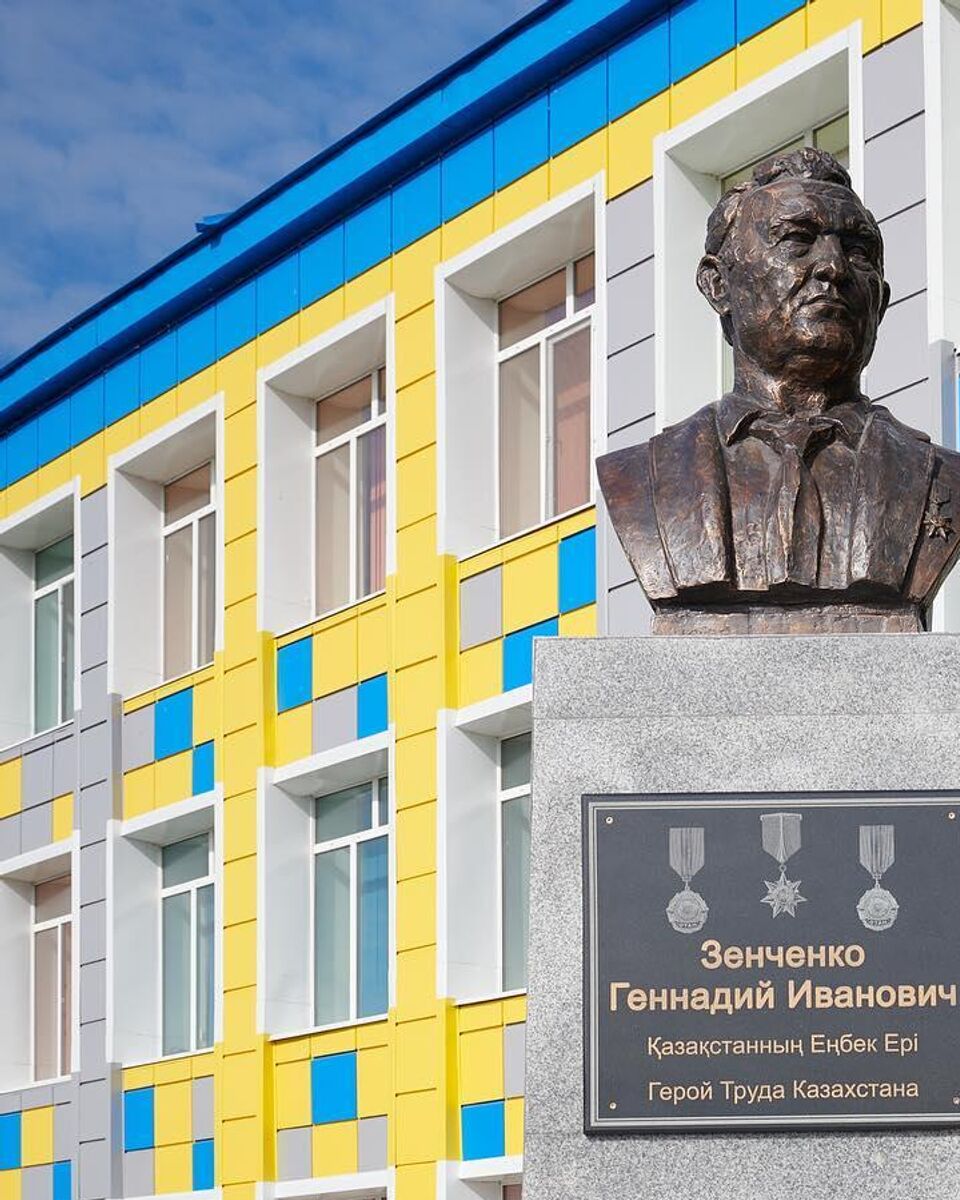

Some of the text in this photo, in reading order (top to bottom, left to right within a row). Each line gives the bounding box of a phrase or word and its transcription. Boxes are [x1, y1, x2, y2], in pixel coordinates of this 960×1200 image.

[701, 939, 866, 969] Зенченко
[609, 979, 957, 1015] Геннадий Иванович
[648, 1033, 918, 1059] Қазақстанның Еңбек Ері
[648, 1079, 919, 1105] Герой Труда Казахстана
